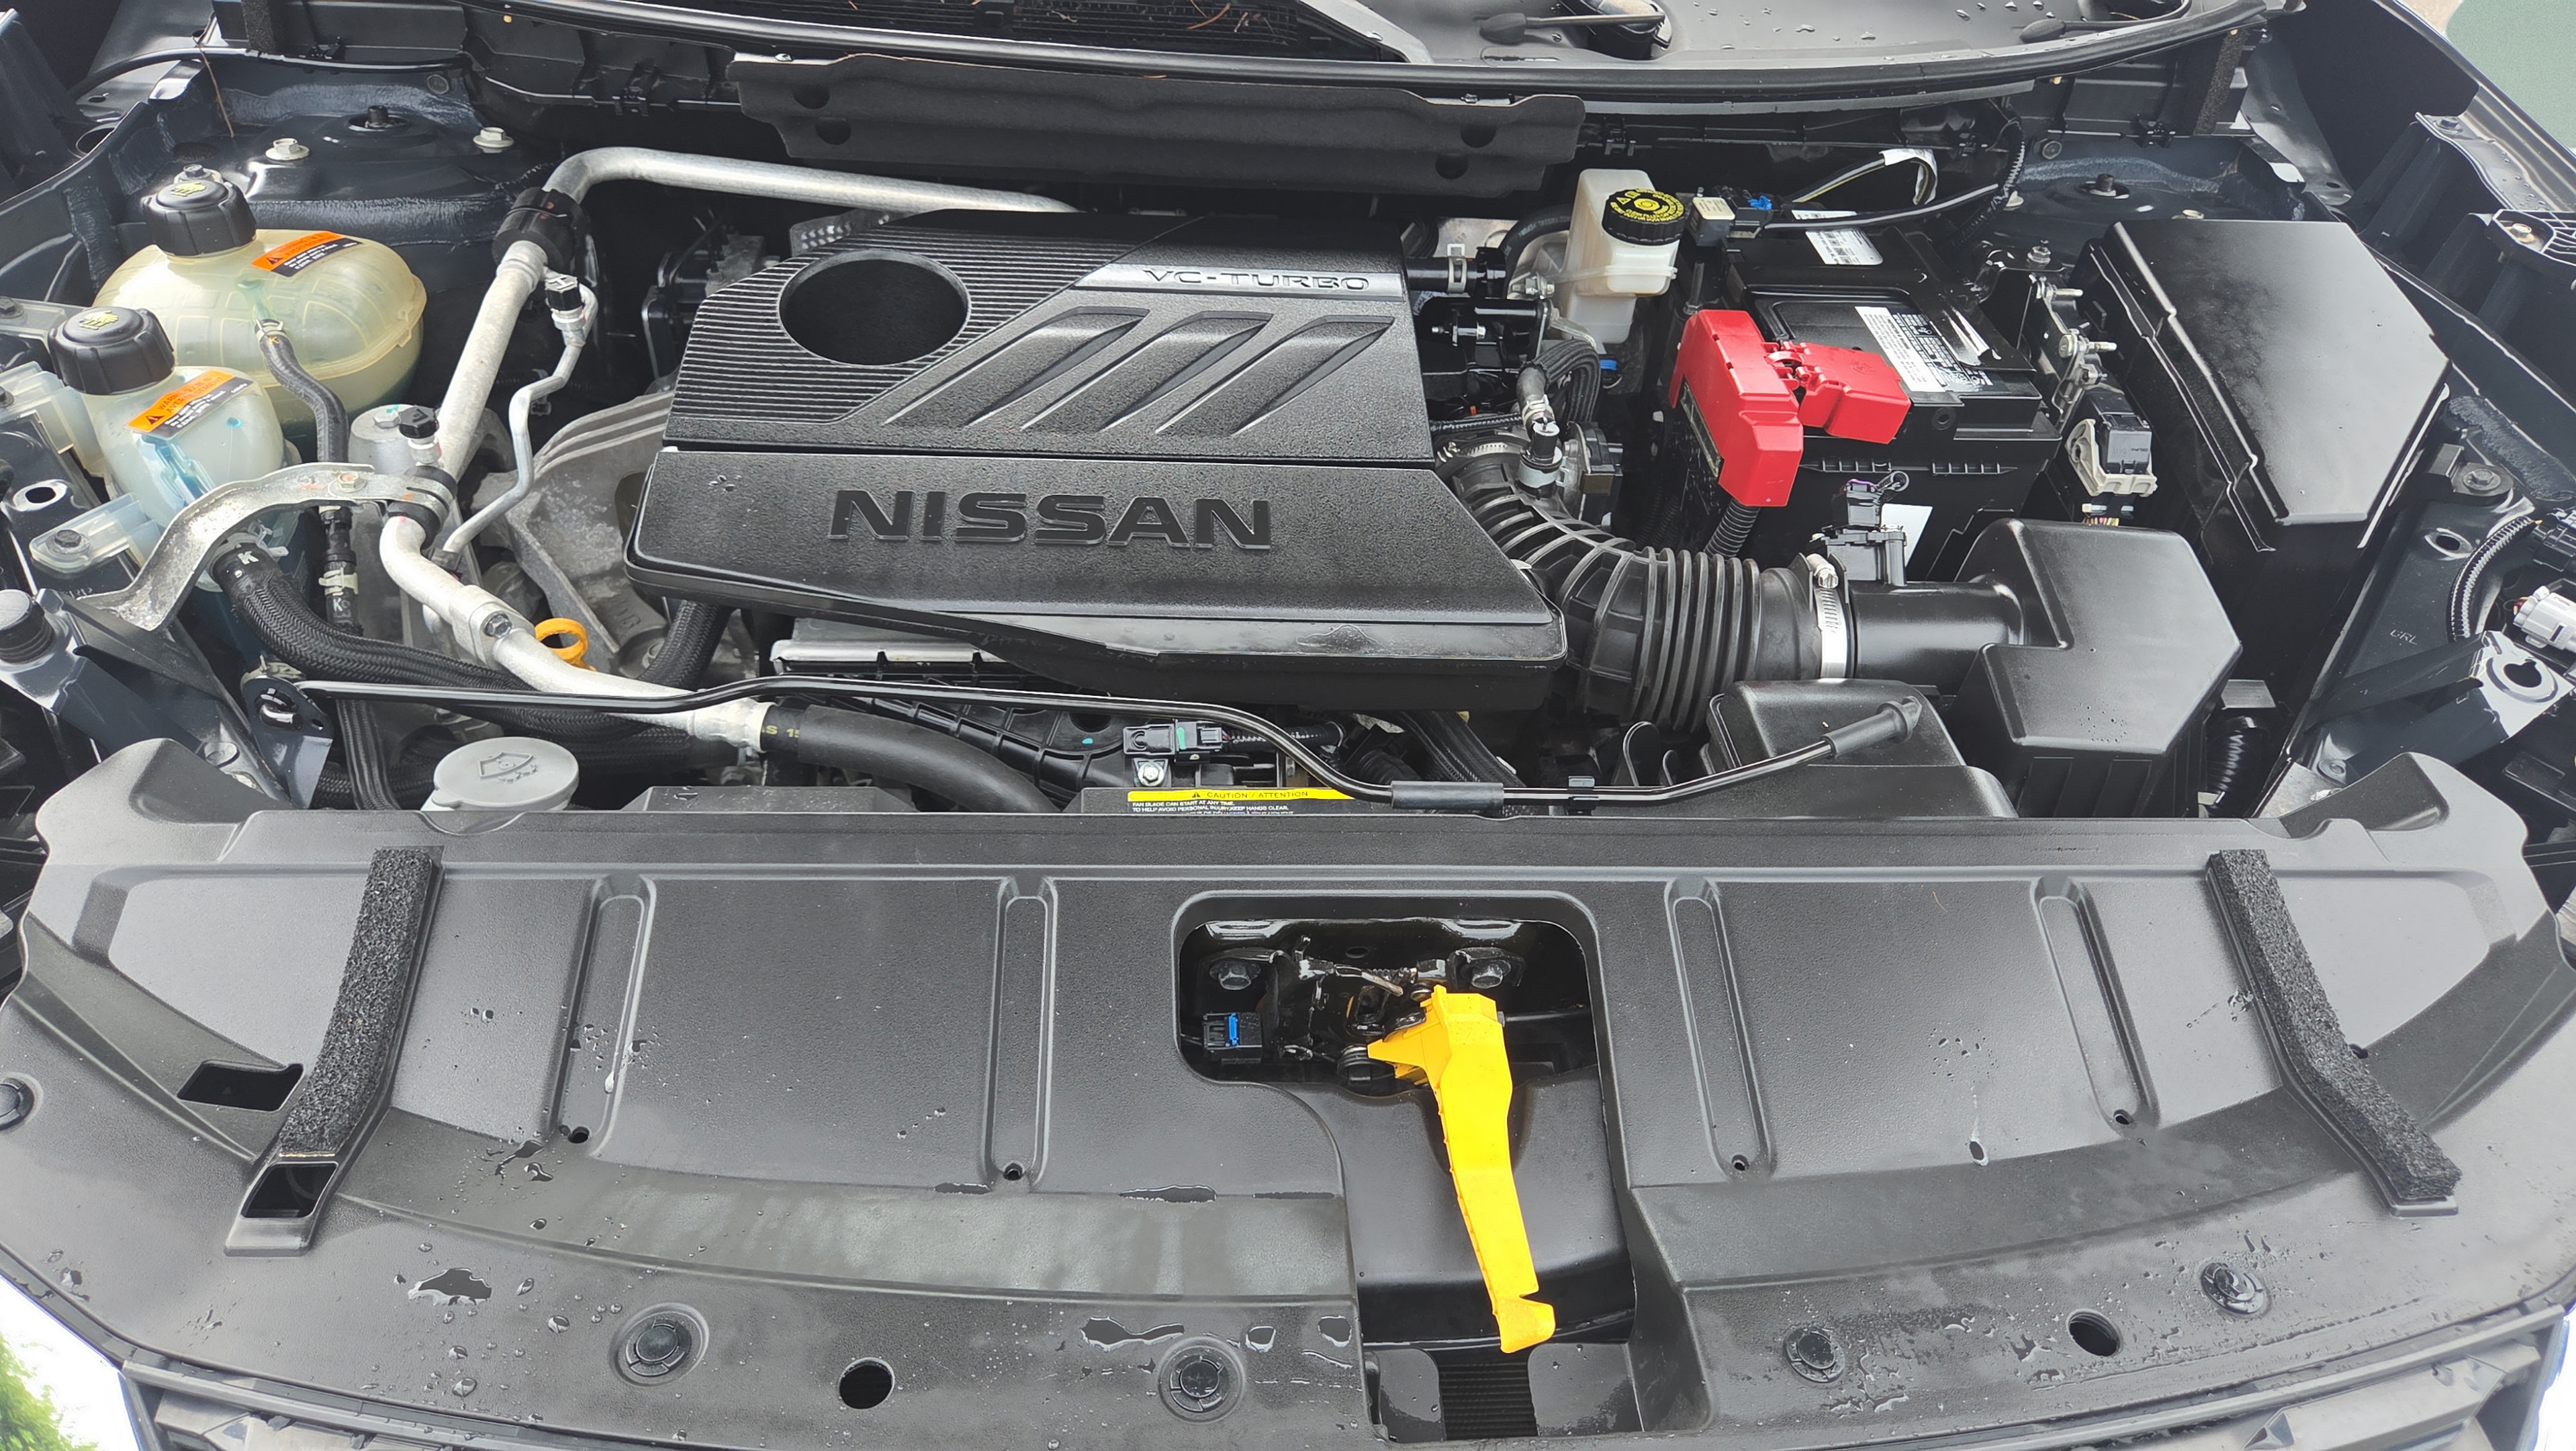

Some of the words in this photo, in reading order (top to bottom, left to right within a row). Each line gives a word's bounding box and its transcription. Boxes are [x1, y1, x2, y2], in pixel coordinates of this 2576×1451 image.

[1143, 269, 1369, 290] VC-TURBO
[827, 489, 1271, 549] NISSAN
[237, 551, 259, 565] K
[1258, 791, 1308, 799] ATTENTION
